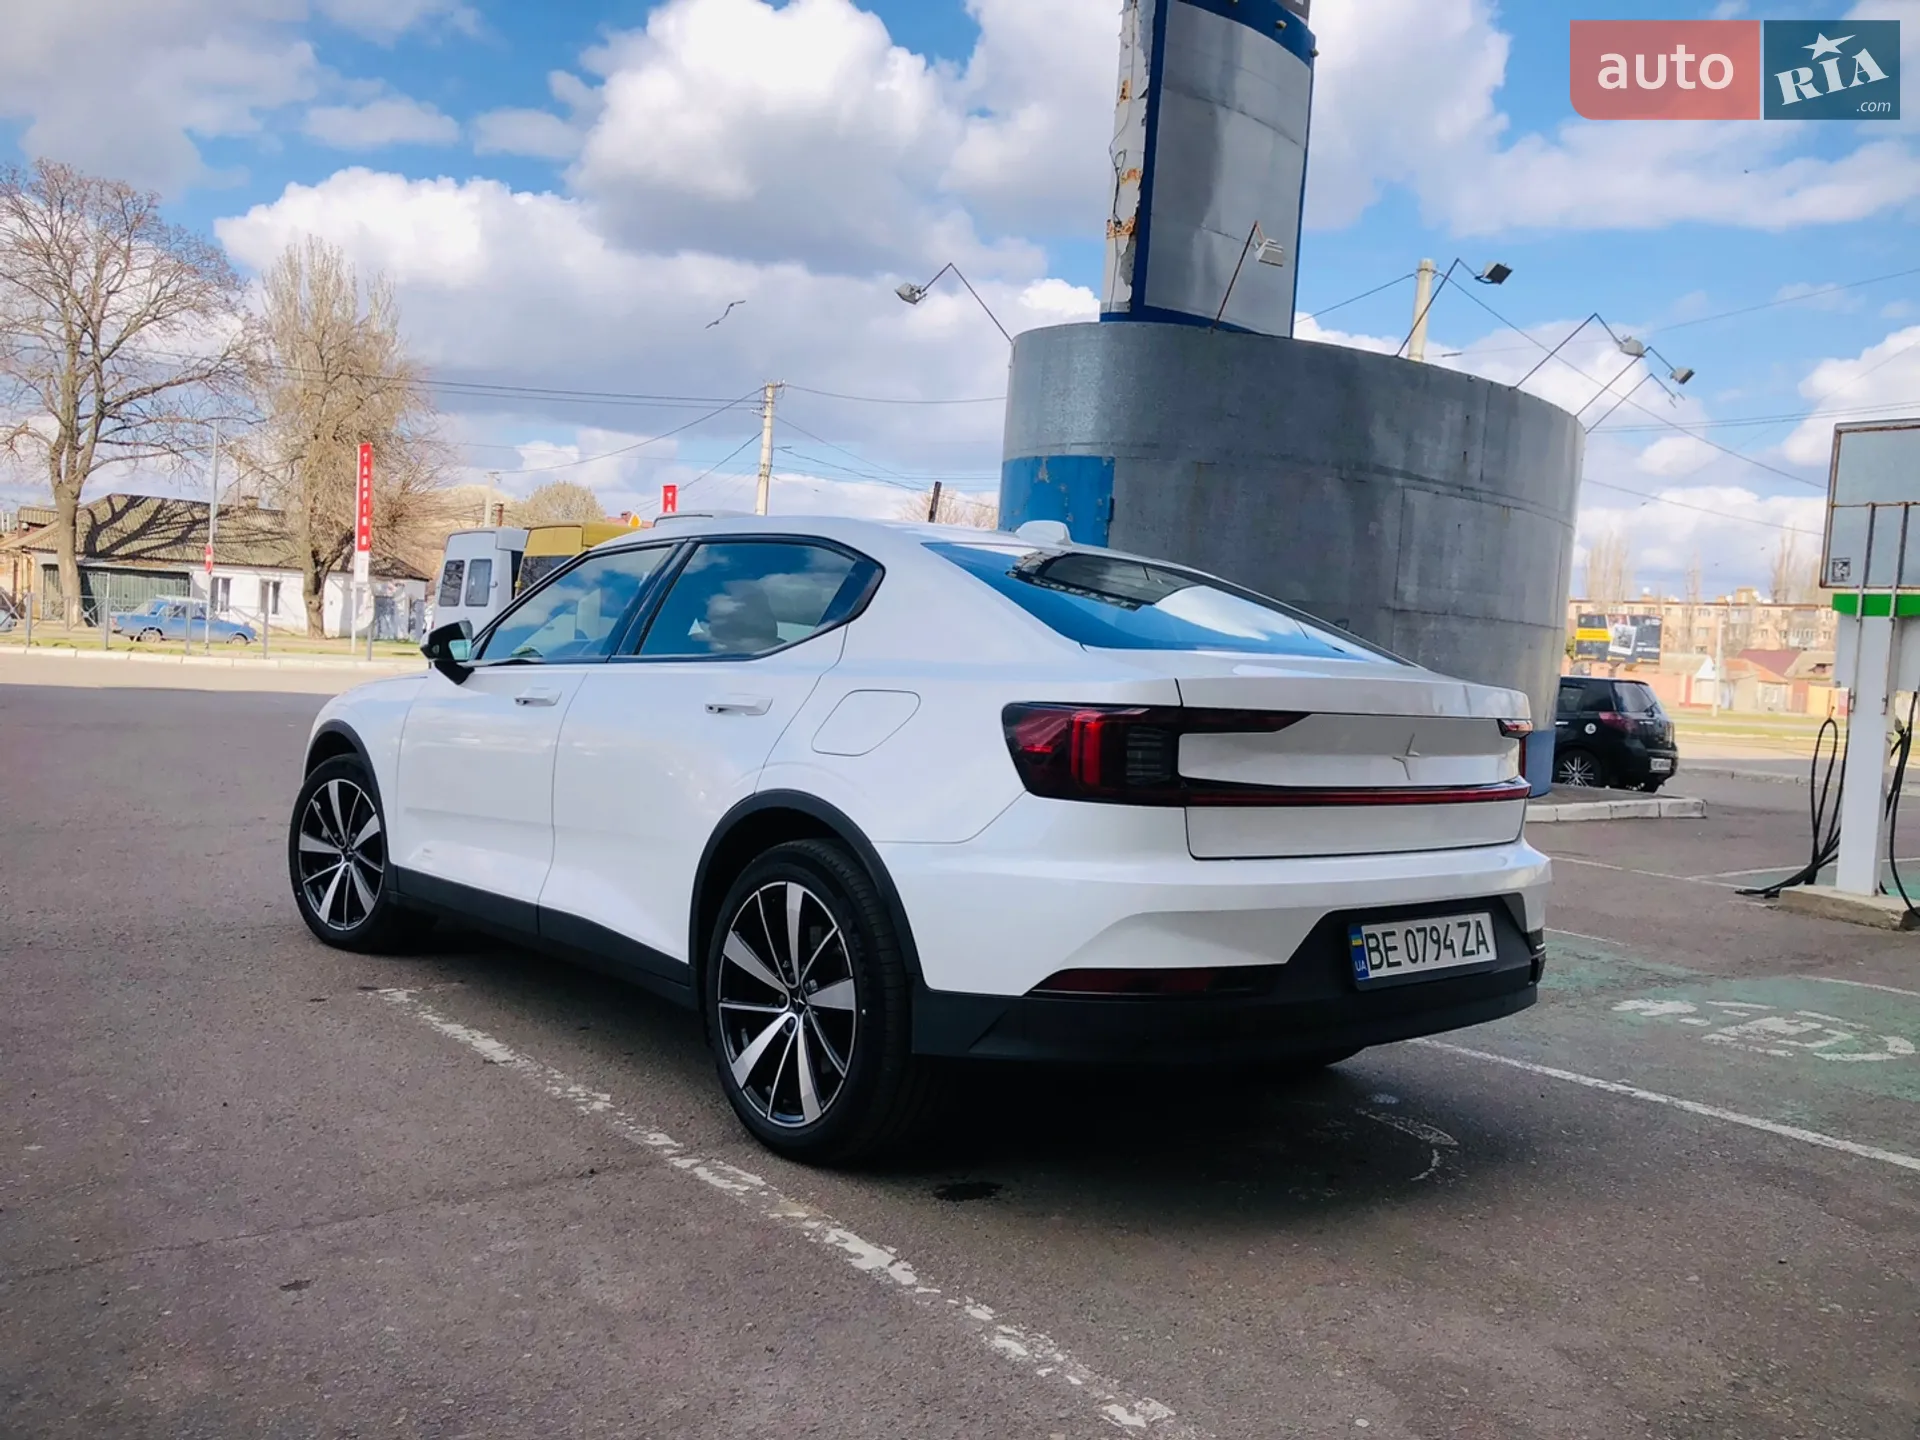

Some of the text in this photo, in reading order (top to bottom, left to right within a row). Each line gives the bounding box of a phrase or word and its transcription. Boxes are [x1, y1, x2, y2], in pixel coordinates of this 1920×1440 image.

[1364, 920, 1491, 971] BE 0794 ZA
[1354, 960, 1367, 972] UA
